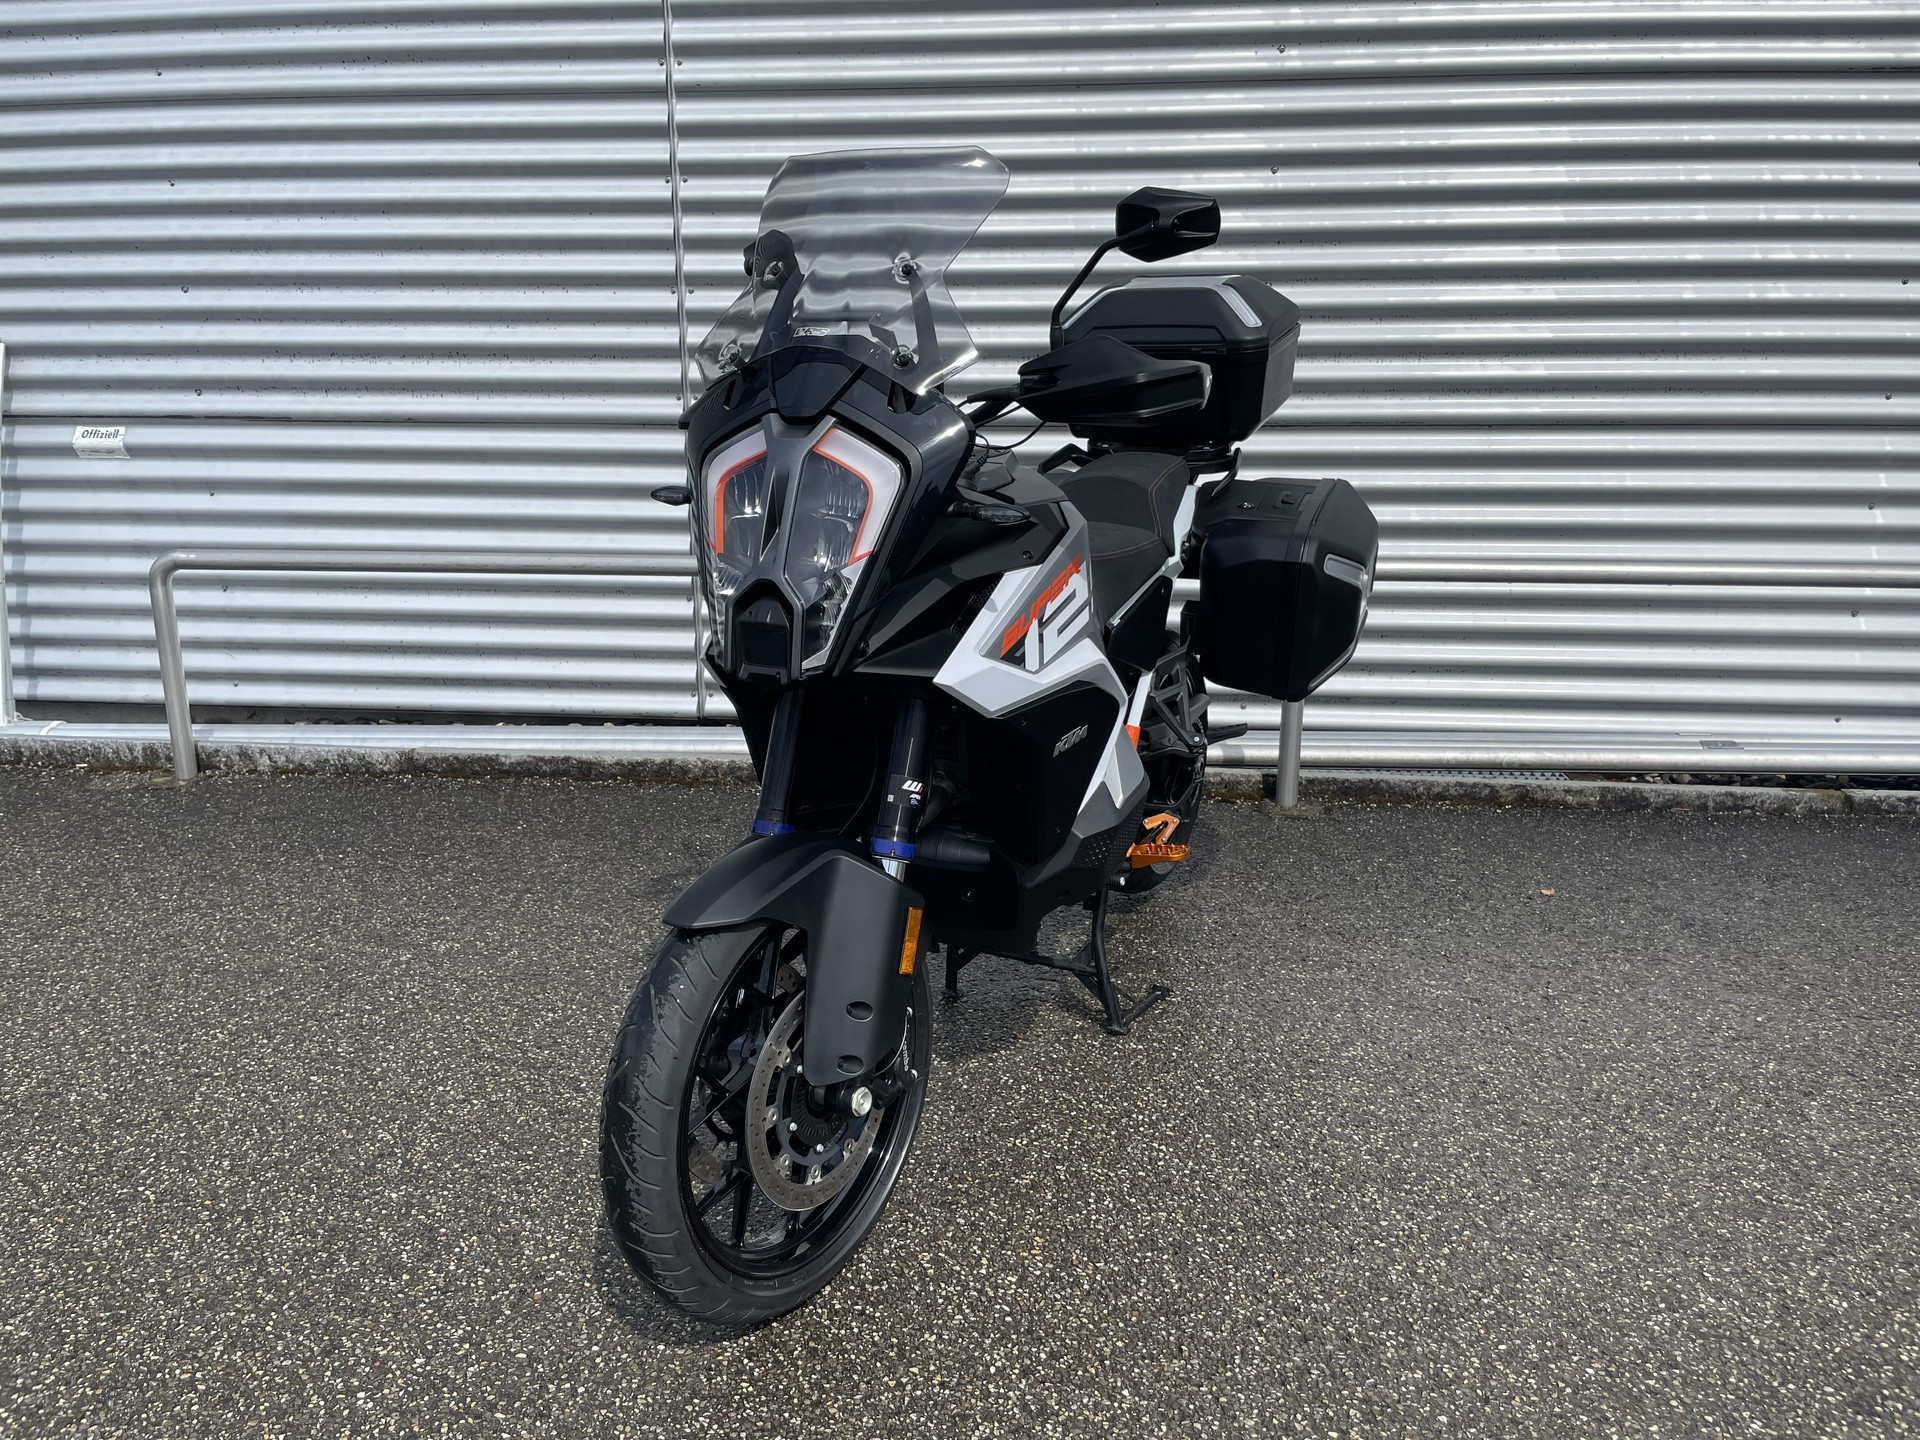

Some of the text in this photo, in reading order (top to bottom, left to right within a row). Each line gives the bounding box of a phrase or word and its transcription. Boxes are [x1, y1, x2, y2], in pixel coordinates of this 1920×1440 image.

[81, 428, 120, 439] Offiziell
[1000, 553, 1082, 660] SUPER
[1052, 724, 1089, 758] KTM
